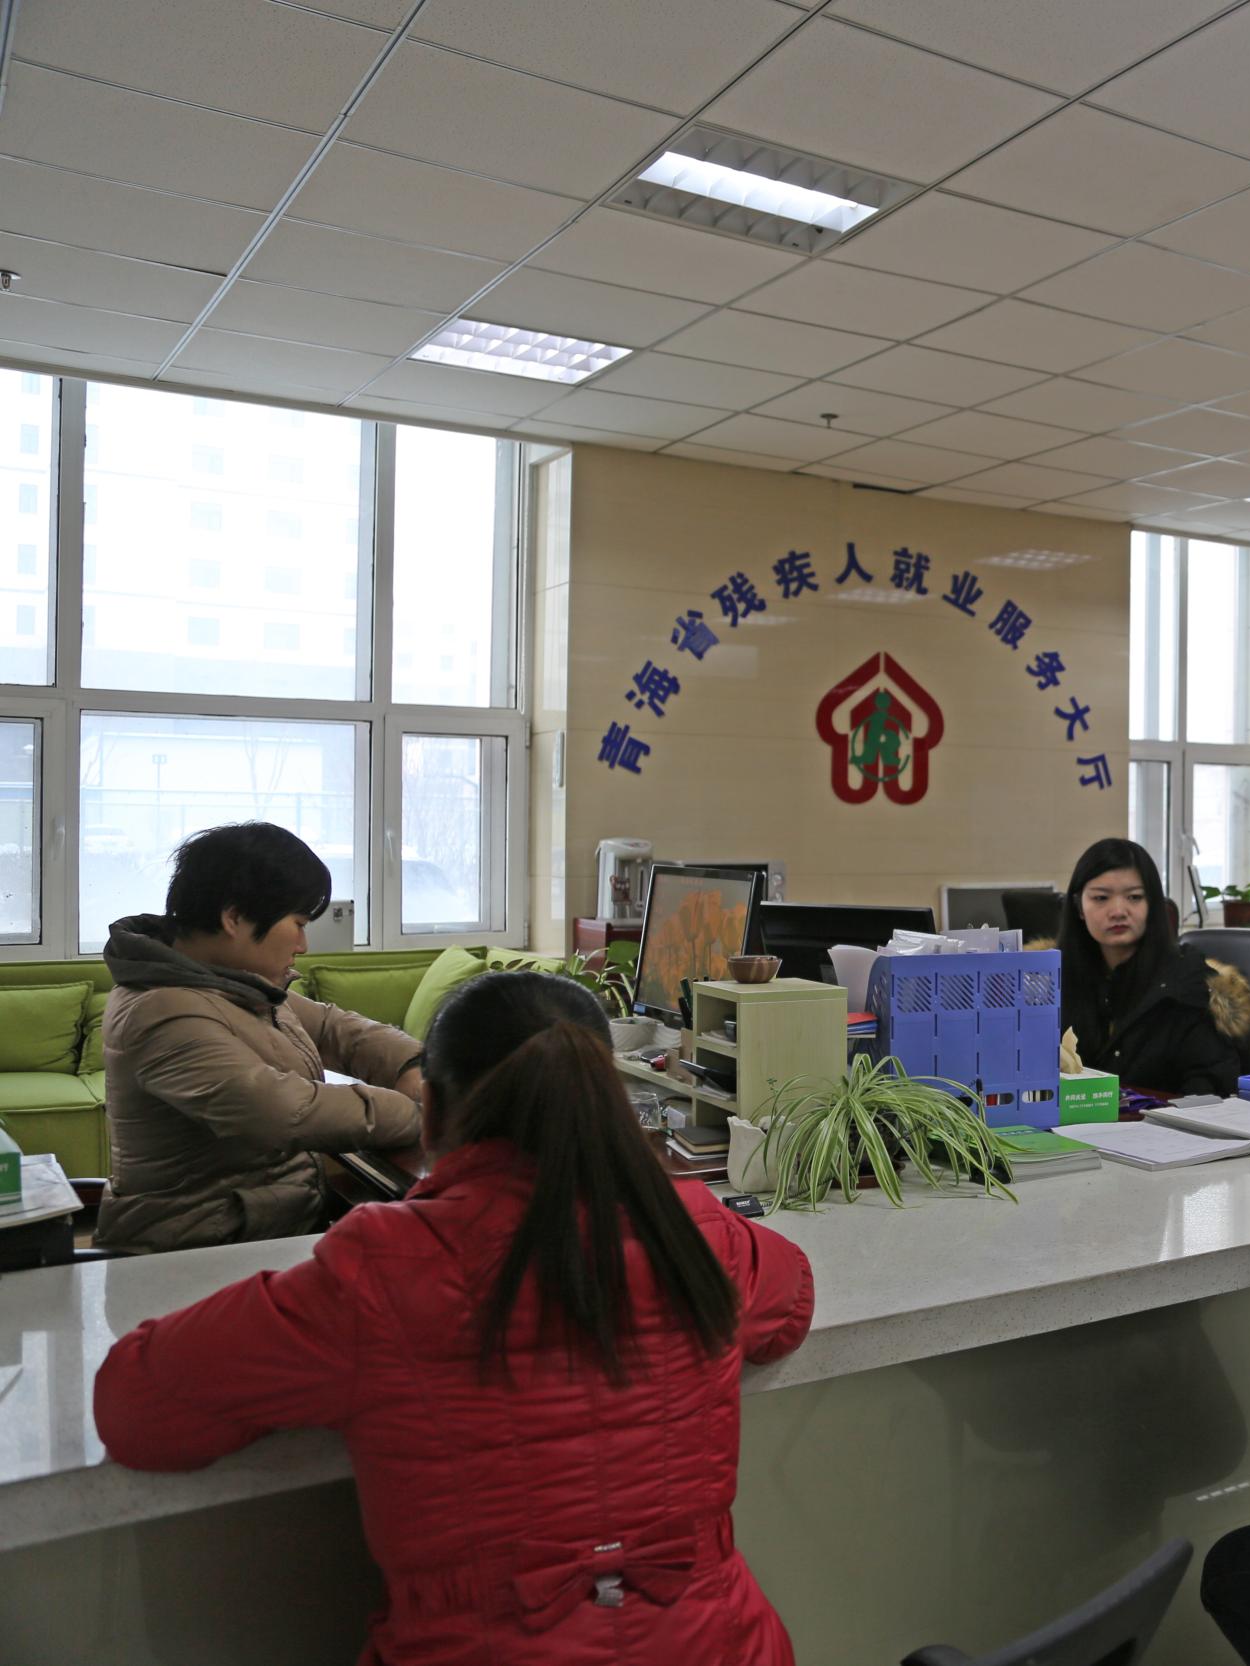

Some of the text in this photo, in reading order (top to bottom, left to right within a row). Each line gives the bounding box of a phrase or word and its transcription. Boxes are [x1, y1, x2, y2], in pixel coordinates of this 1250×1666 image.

[597, 541, 1113, 792] 青海省残疾人就业服务大厅
